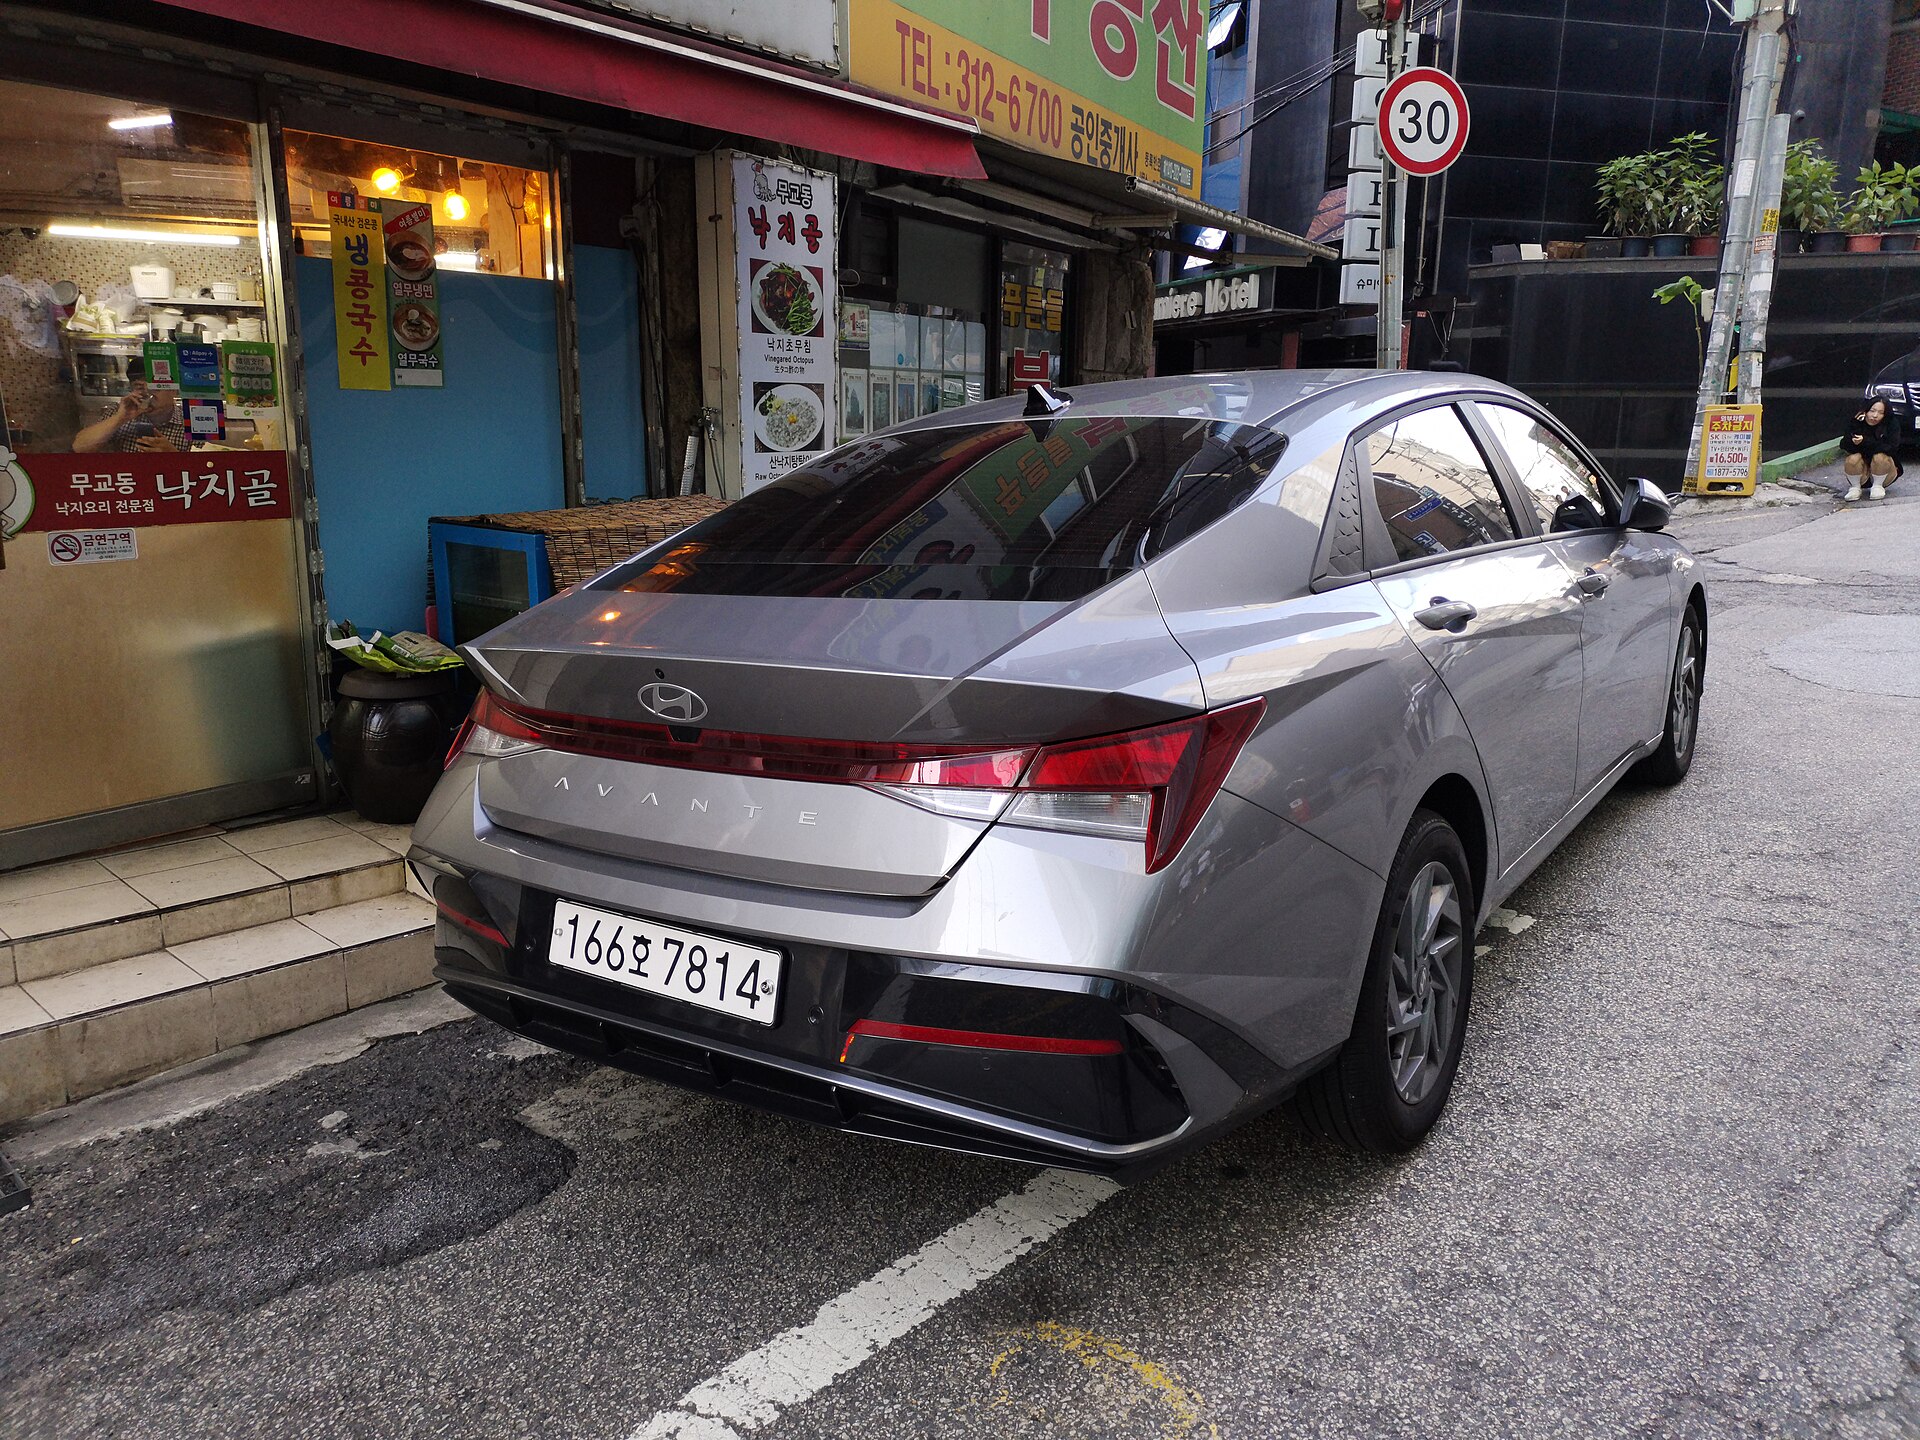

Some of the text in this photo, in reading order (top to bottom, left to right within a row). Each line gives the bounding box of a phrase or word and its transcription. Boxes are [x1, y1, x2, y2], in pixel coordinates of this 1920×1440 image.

[1398, 99, 1450, 145] 30
[1070, 104, 1138, 175] 공인중개사
[776, 178, 814, 210] 무교동
[333, 213, 379, 231] 국내산 검은콩
[748, 204, 823, 254] 낙지골
[392, 281, 435, 299] 열무냉면
[1204, 273, 1260, 315] Motel
[1002, 281, 1064, 332] 푸른들
[767, 337, 812, 354] 낙지초무침
[397, 352, 439, 368] 열무국수
[764, 354, 814, 365] Vinegared Octopus
[1711, 421, 1752, 432] 주차금지
[70, 472, 137, 496] 무교동
[755, 472, 767, 480] Raw
[155, 469, 278, 510] 낙지골
[55, 498, 155, 516] 낙지요리 전문점
[83, 532, 131, 547] 금연구역
[554, 777, 819, 826] AVANTE
